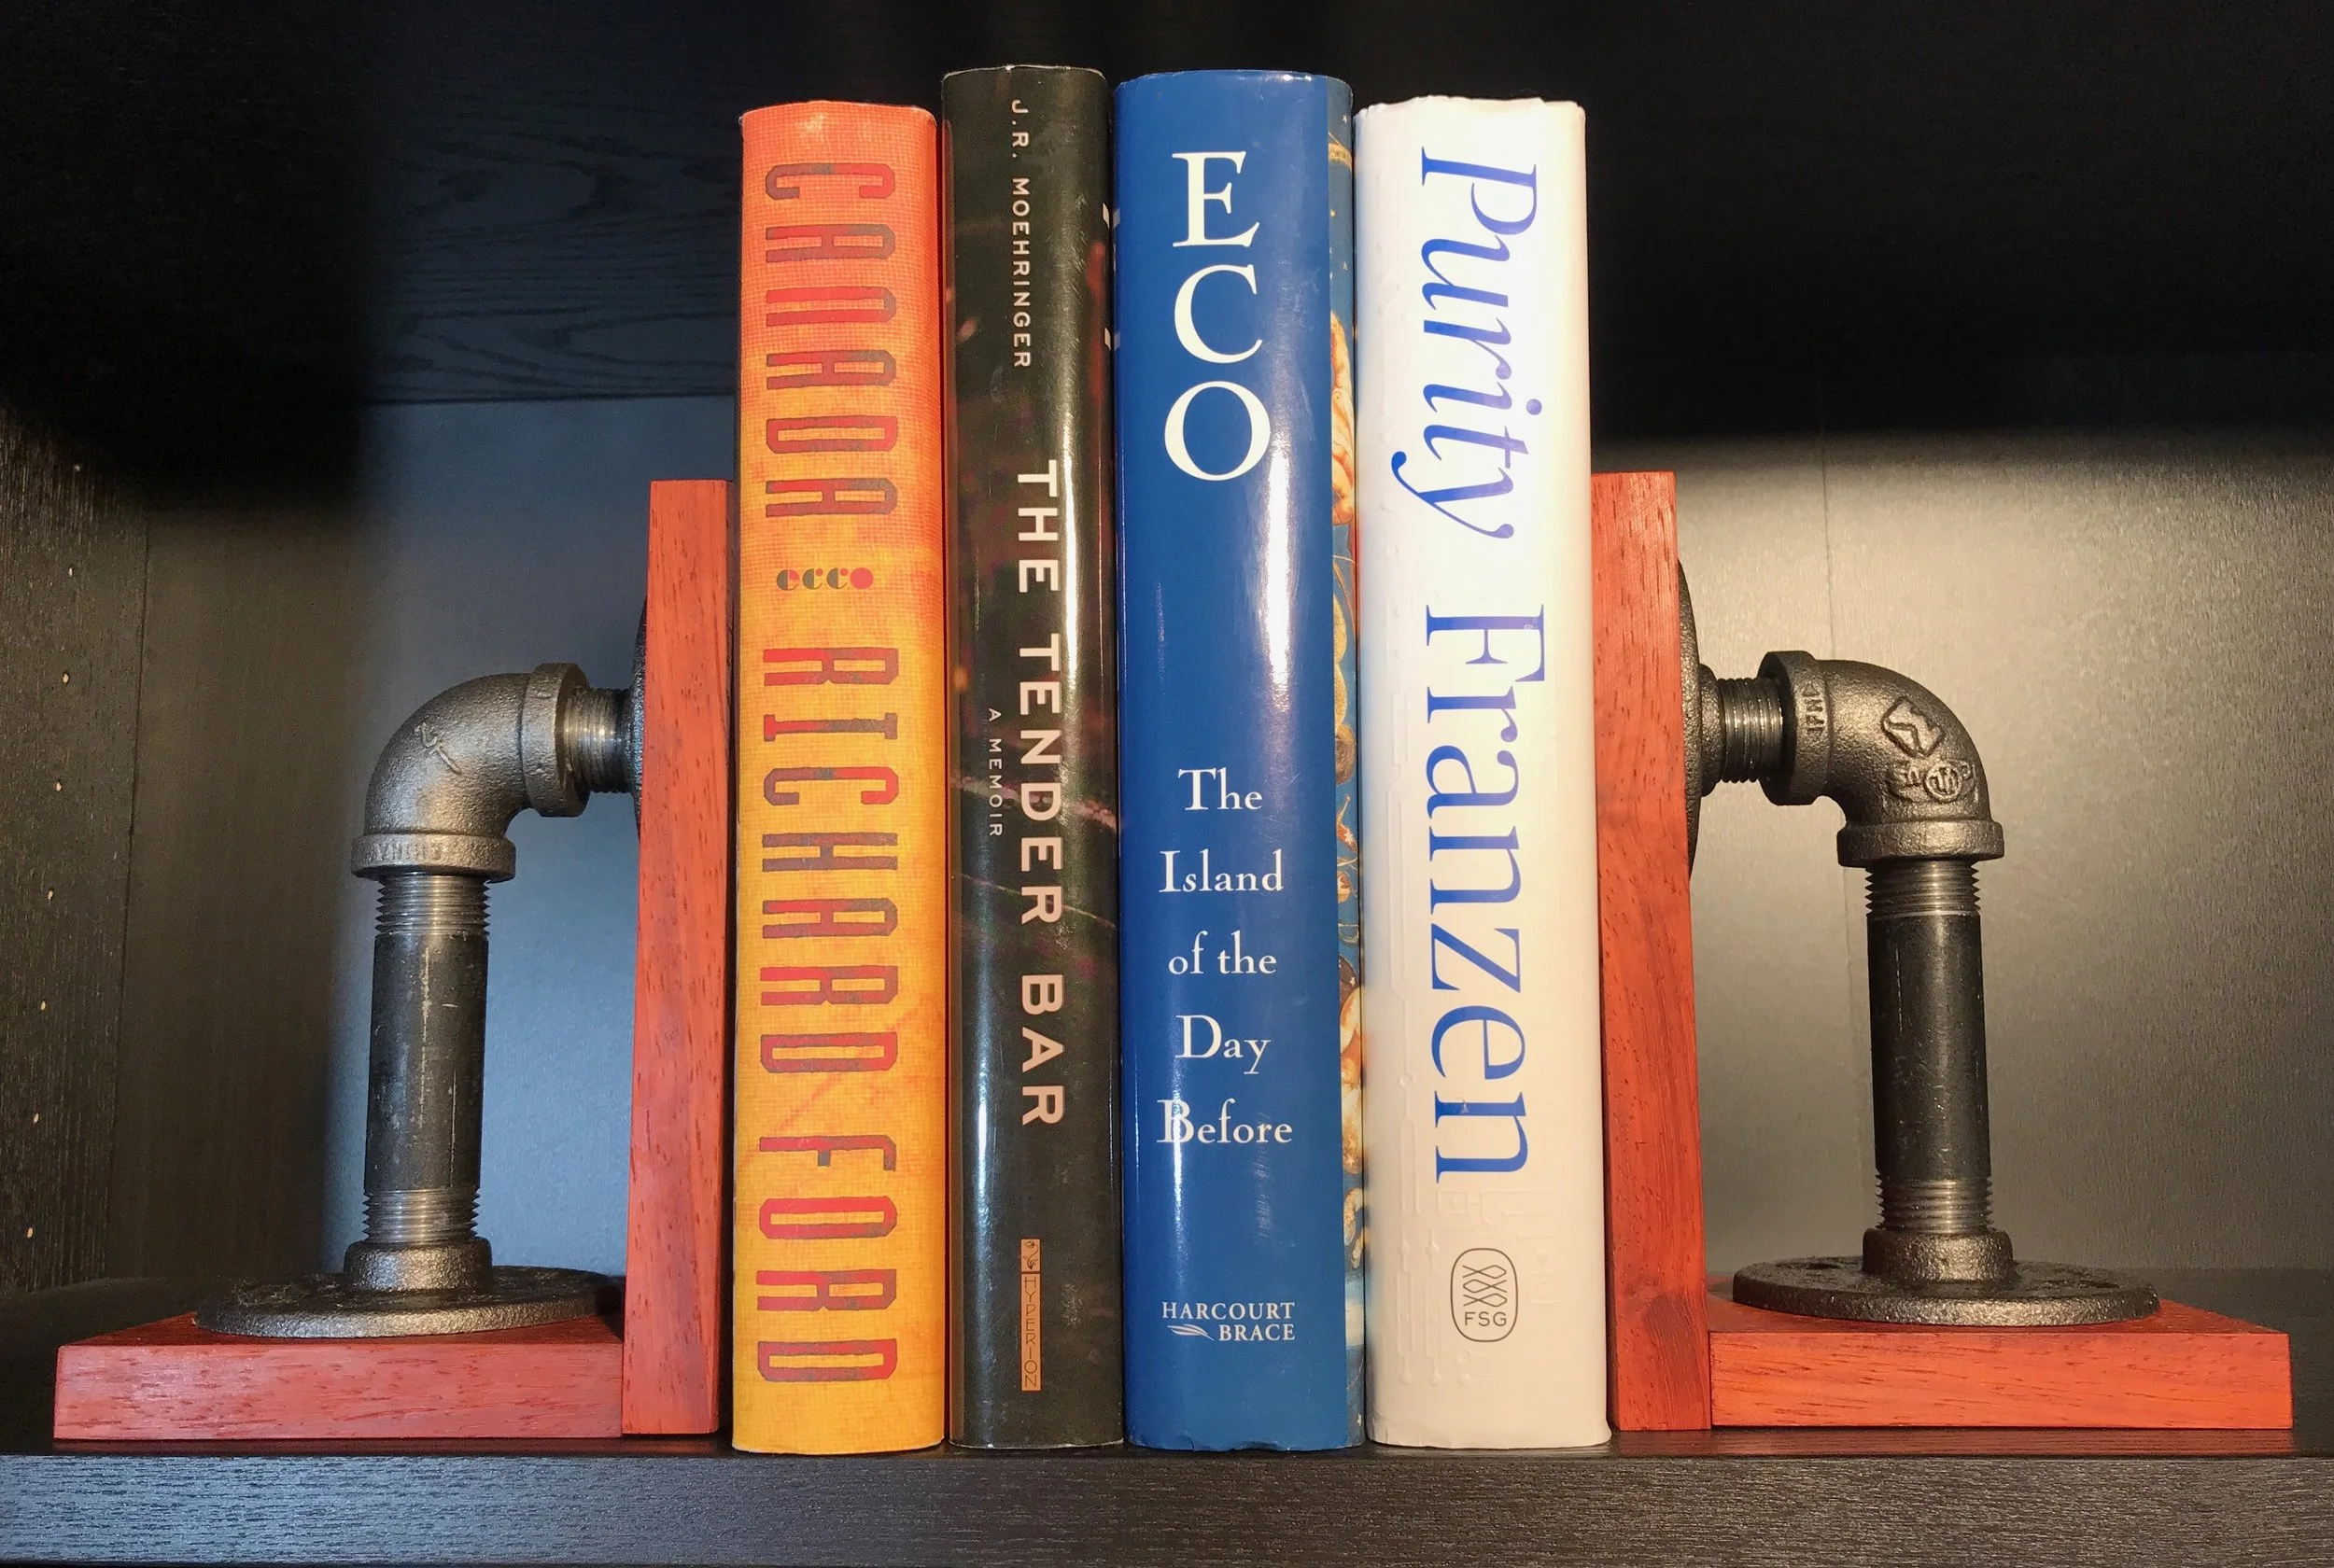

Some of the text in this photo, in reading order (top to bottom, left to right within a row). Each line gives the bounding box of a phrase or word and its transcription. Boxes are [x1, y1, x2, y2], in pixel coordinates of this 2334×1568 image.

[1011, 99, 1033, 369] J.R. MOEHRINGER
[765, 161, 899, 519] CANADA
[1164, 151, 1272, 482] ECO
[1390, 147, 1543, 539] Purity
[776, 567, 874, 592] ecco
[988, 707, 1004, 837] A MEMOIR
[1017, 460, 1064, 1126] THE TENDER BAR
[1177, 767, 1263, 811] The
[1159, 848, 1285, 893] Island
[1426, 604, 1546, 1183] Franzen
[1168, 931, 1278, 975] of the
[756, 647, 899, 1382] RICHARD FORD
[1175, 1015, 1272, 1075] Day
[1157, 1099, 1294, 1144] Before
[1024, 1277, 1037, 1388] HYPERION
[1161, 1301, 1296, 1321] HARCOURT
[1218, 1323, 1296, 1341] BRACE
[1464, 1311, 1508, 1327] FSG
